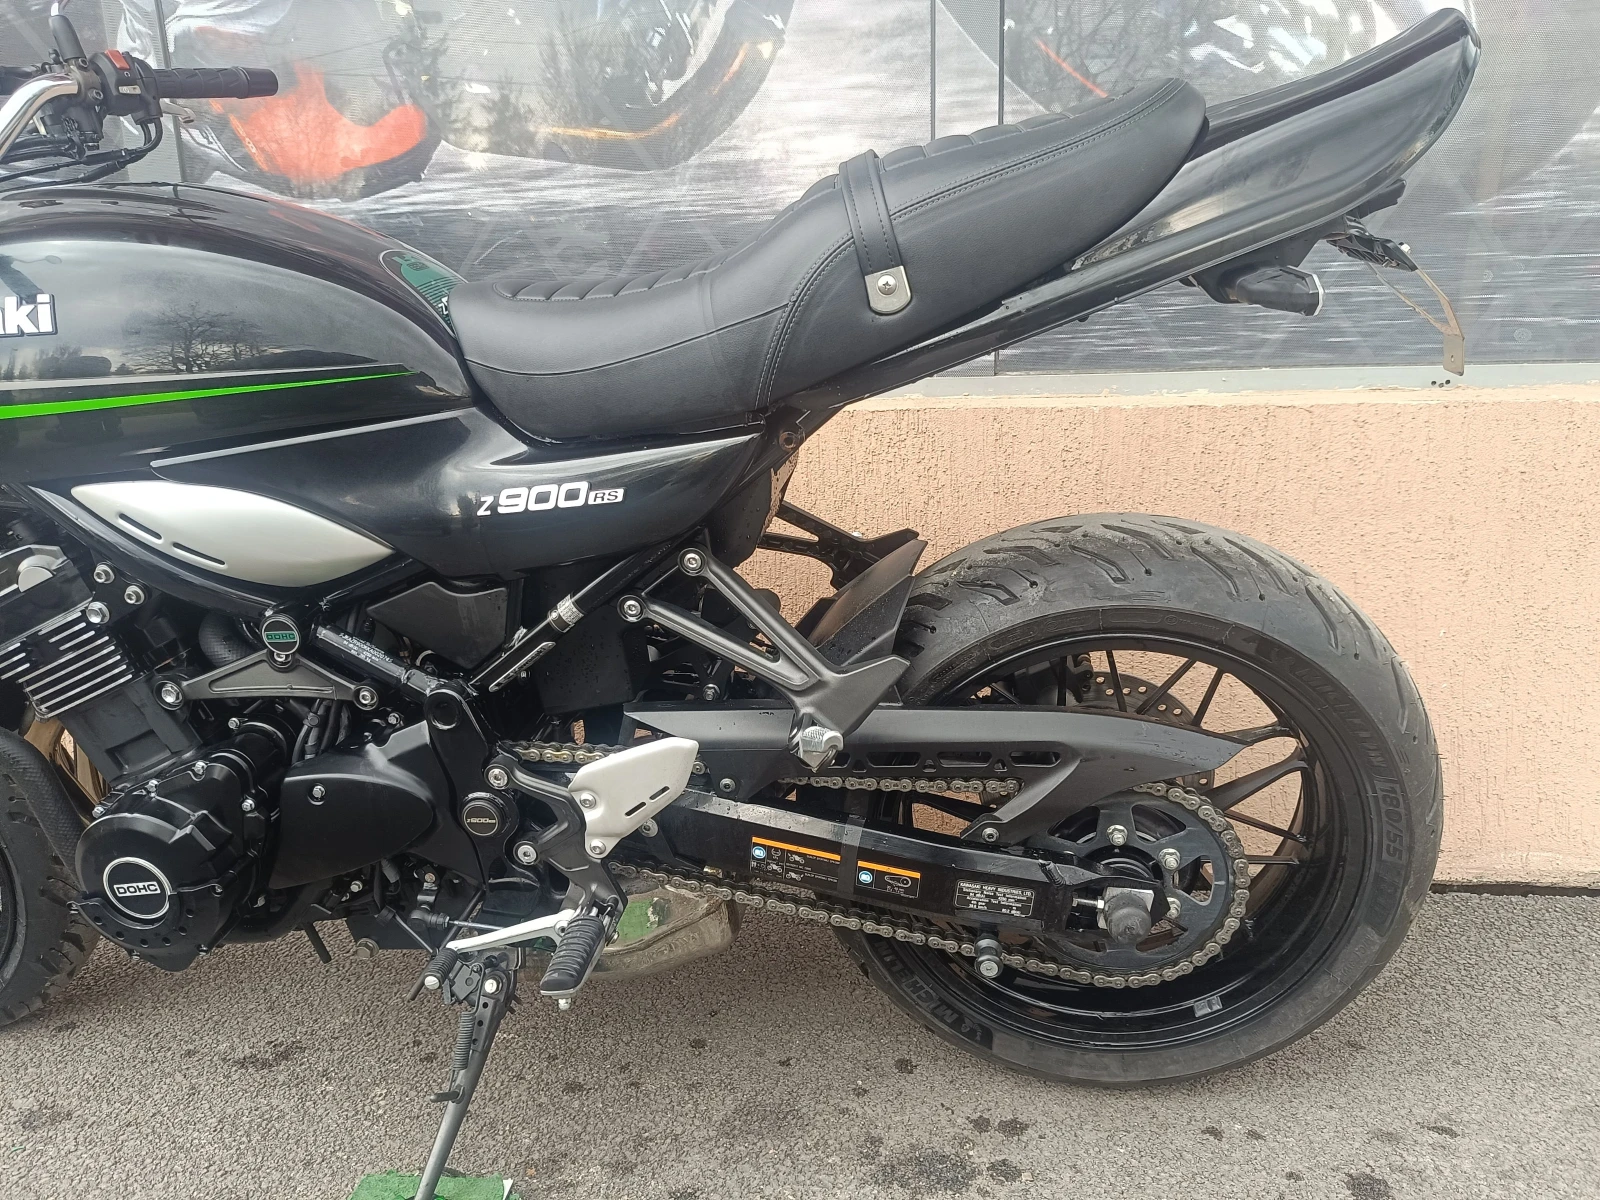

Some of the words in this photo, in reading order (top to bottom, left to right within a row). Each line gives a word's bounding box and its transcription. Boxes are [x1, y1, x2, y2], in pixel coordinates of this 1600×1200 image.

[0, 294, 54, 335] ki
[591, 489, 621, 503] RS
[1379, 785, 1403, 860] 180/55
[116, 884, 158, 895] DOHC
[873, 941, 959, 1024] MICHELIN
